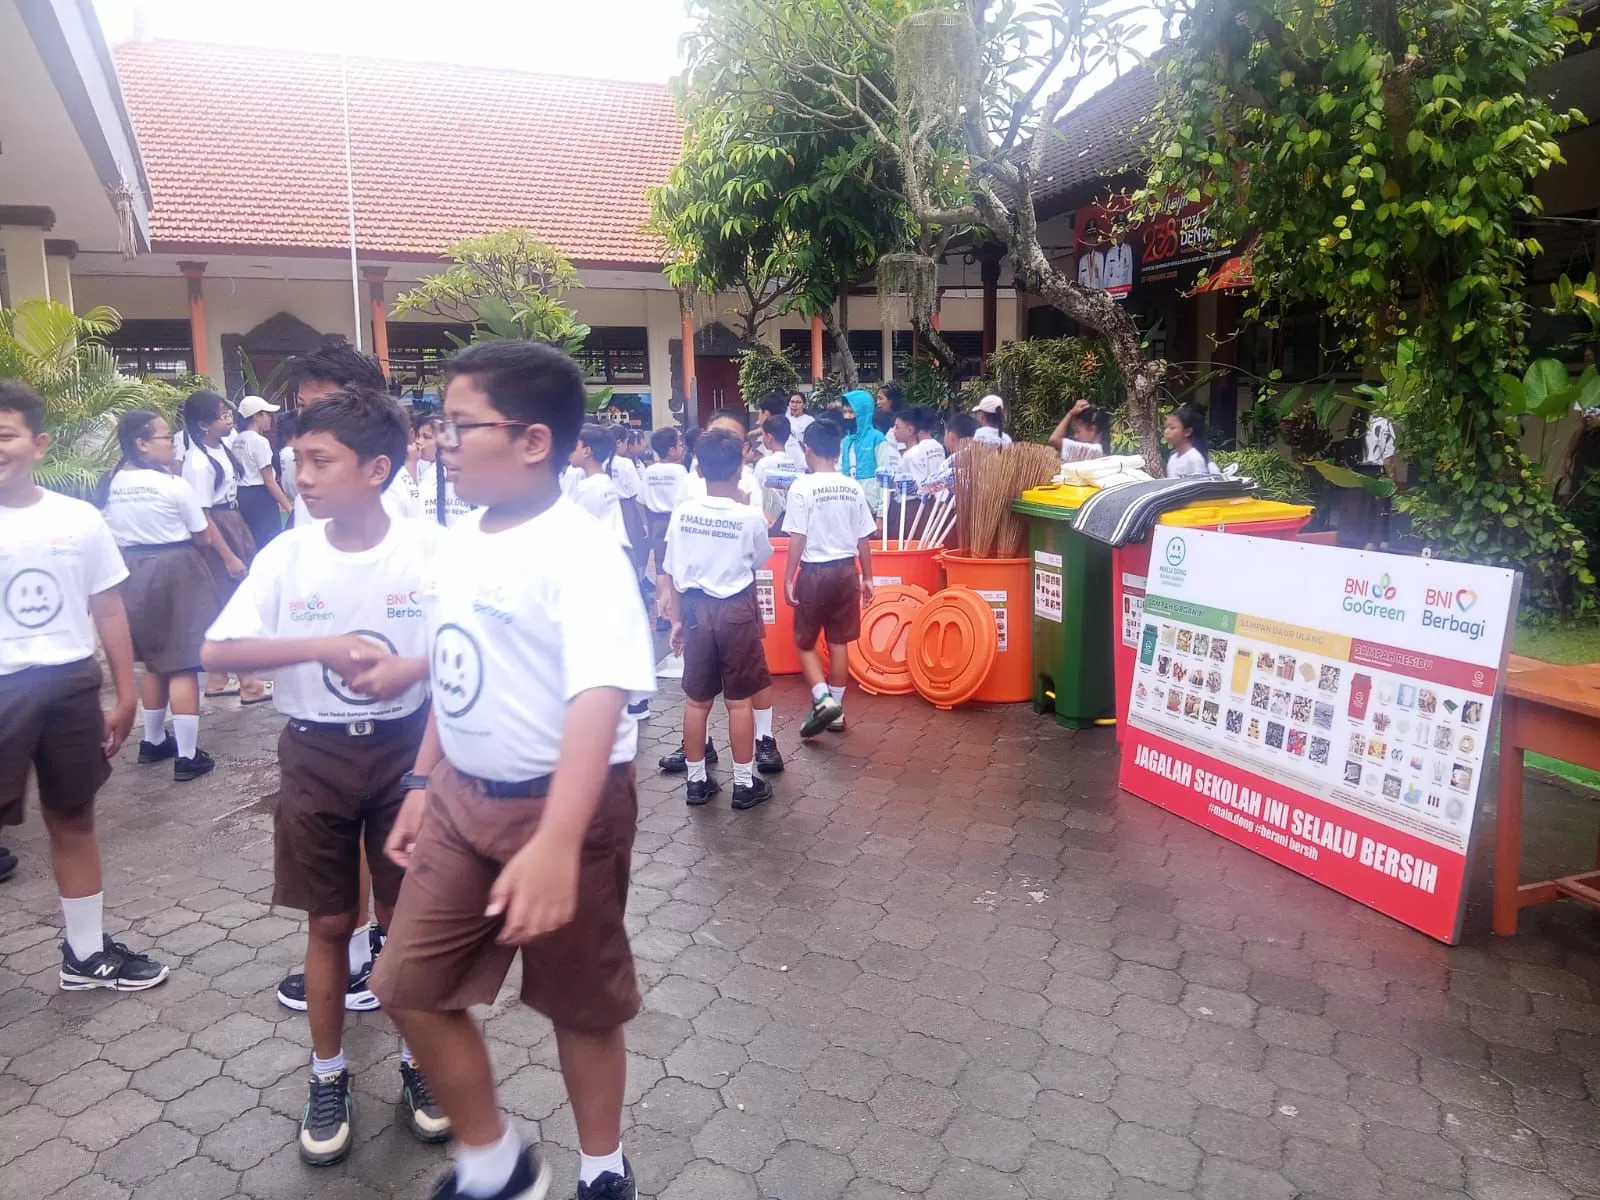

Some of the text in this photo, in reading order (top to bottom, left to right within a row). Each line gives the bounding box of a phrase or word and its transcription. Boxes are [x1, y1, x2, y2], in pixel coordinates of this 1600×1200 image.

[680, 513, 745, 532] #MALU.DONG
[1344, 578, 1369, 597] BNI
[386, 594, 407, 606] BNI
[1342, 595, 1406, 622] GoGreen
[1425, 588, 1453, 609] BNI
[386, 607, 422, 619] Berba
[1240, 619, 1272, 633] SAMPAH
[1272, 626, 1296, 638] DAUR
[1421, 609, 1486, 641] Berbagi
[1354, 643, 1395, 664] SAMPAH
[1395, 653, 1434, 671] RESIDU
[1133, 743, 1193, 788] JAGALAH
[1193, 768, 1263, 818] SEKOLAH
[1263, 797, 1290, 830] INI
[1290, 808, 1358, 860] SELALU
[1358, 836, 1439, 894] BERSIH
[1207, 801, 1319, 861] #malu.dong #berani bersih
